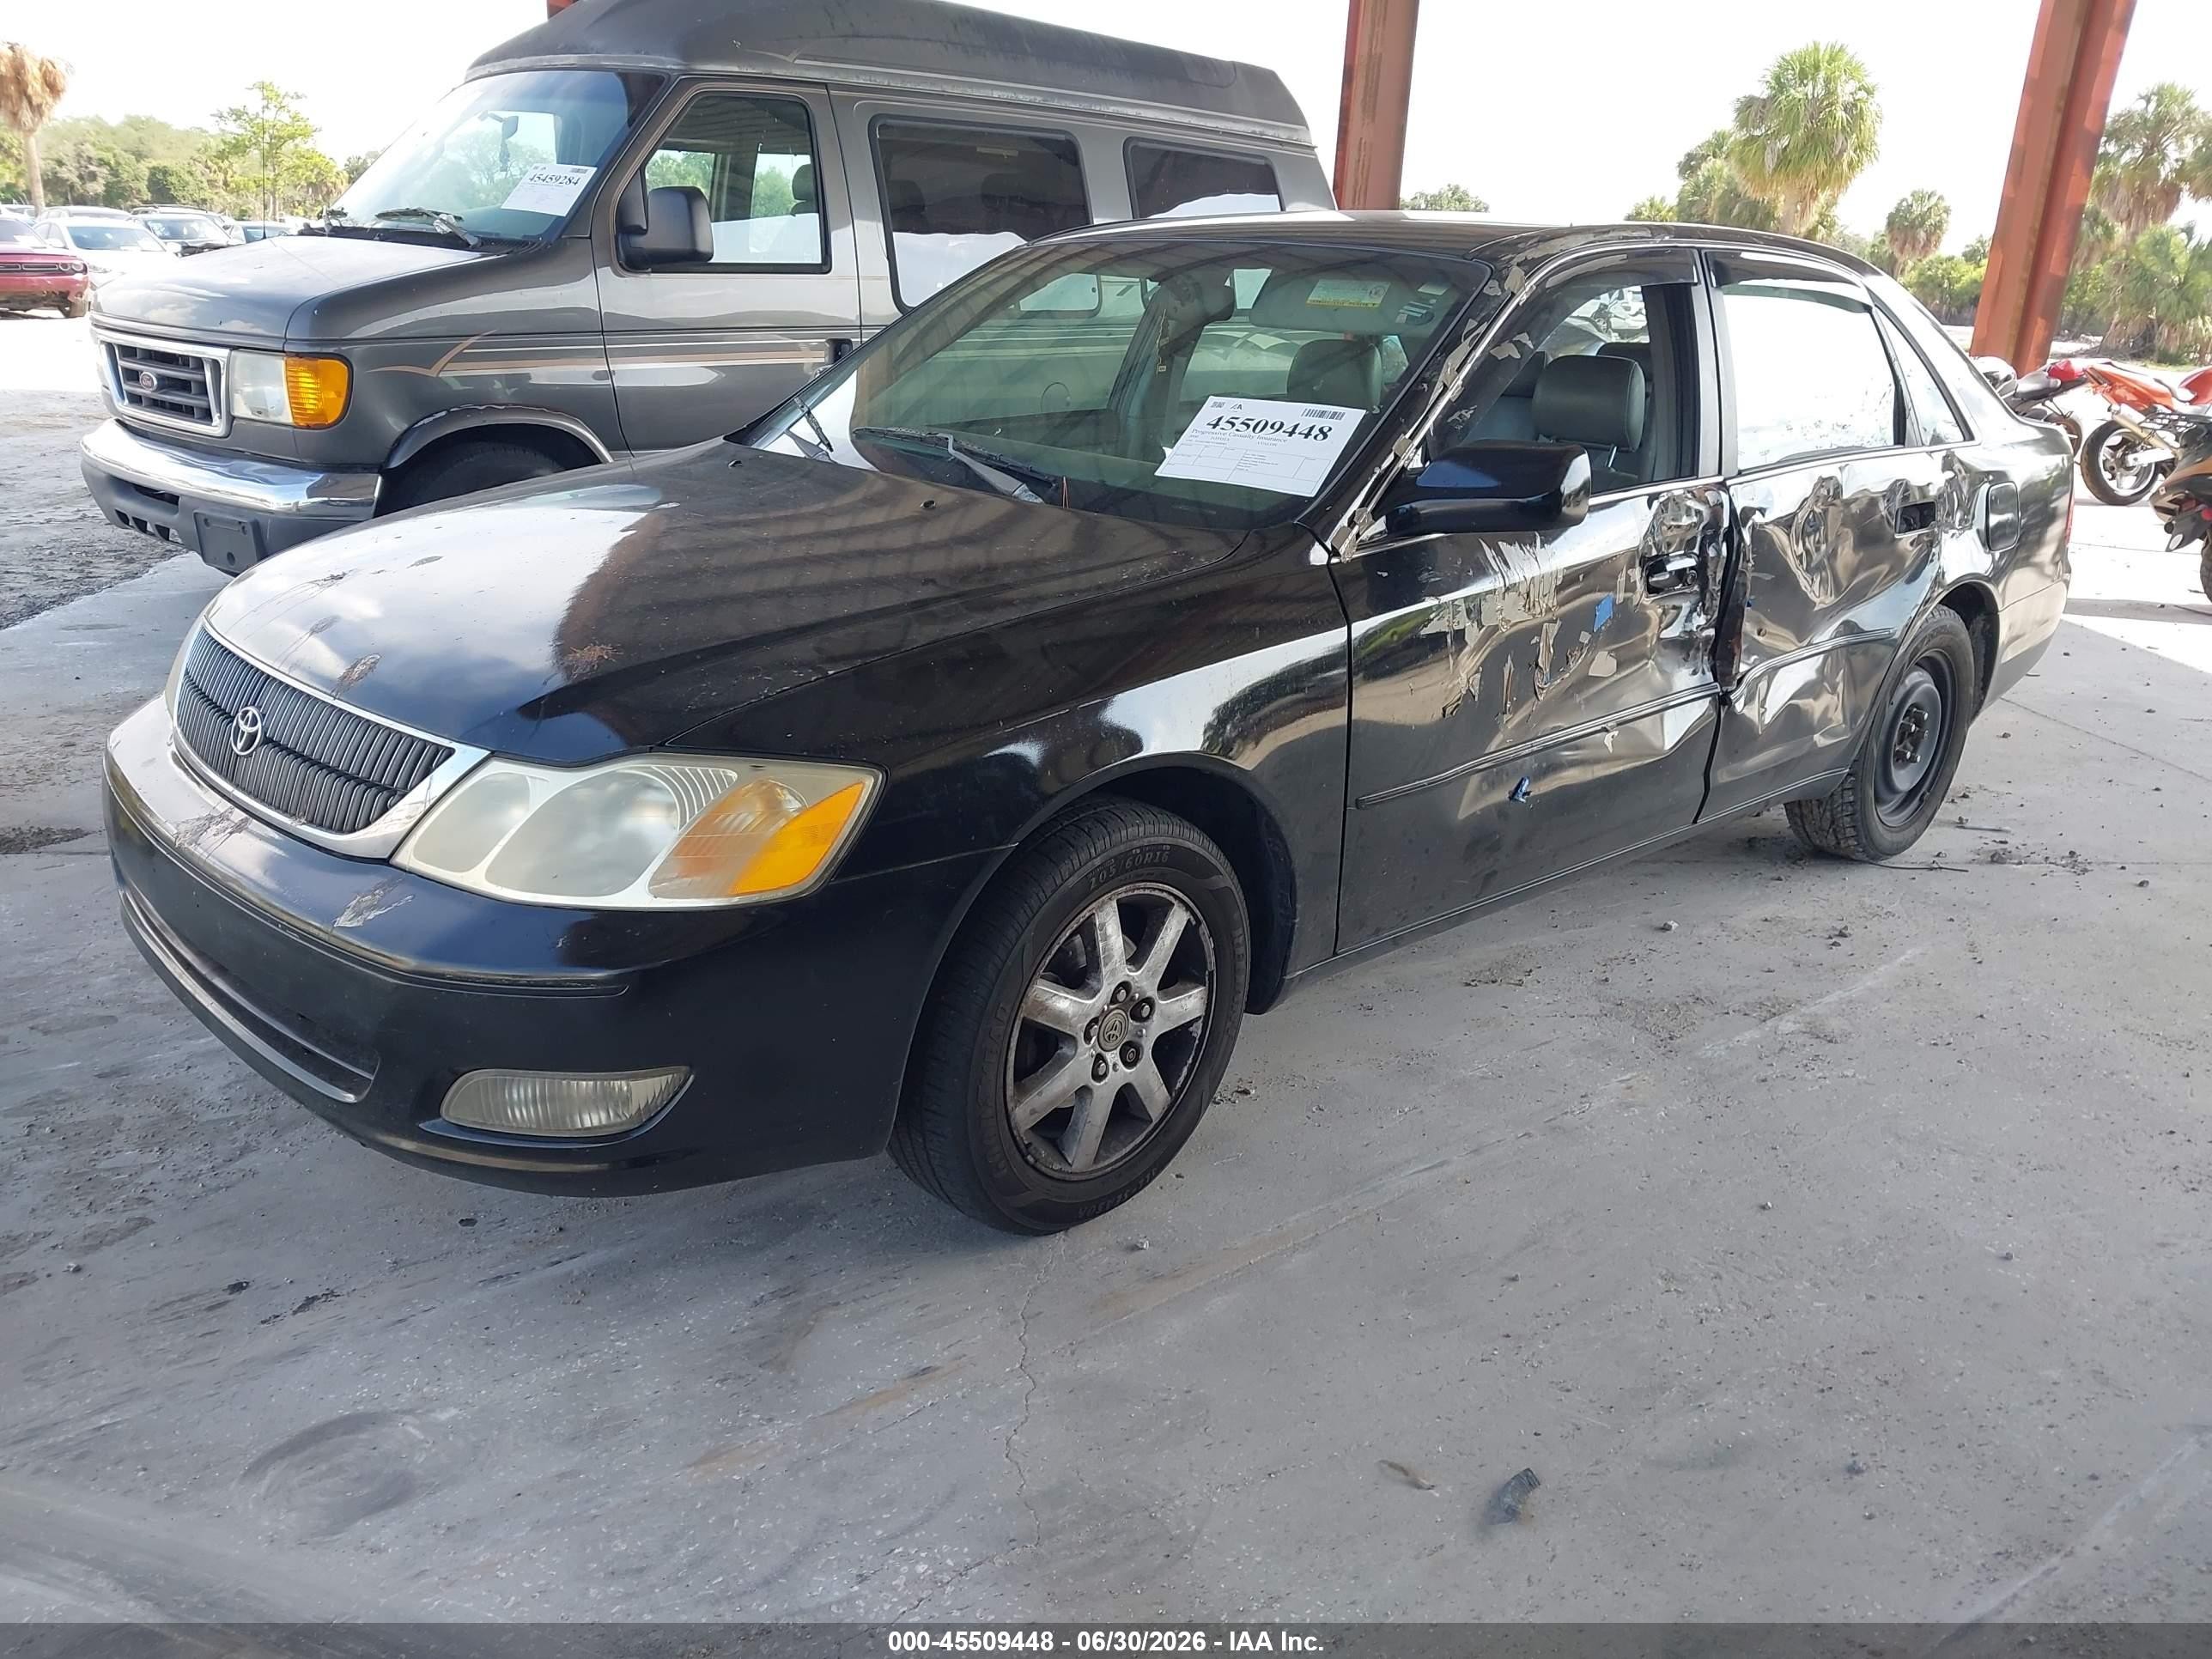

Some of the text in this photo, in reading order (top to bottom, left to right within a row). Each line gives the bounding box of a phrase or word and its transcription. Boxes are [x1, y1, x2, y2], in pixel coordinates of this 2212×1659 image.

[529, 173, 581, 185] 45459284
[1206, 416, 1333, 441] 45509448
[1256, 434, 1288, 443] Insurance
